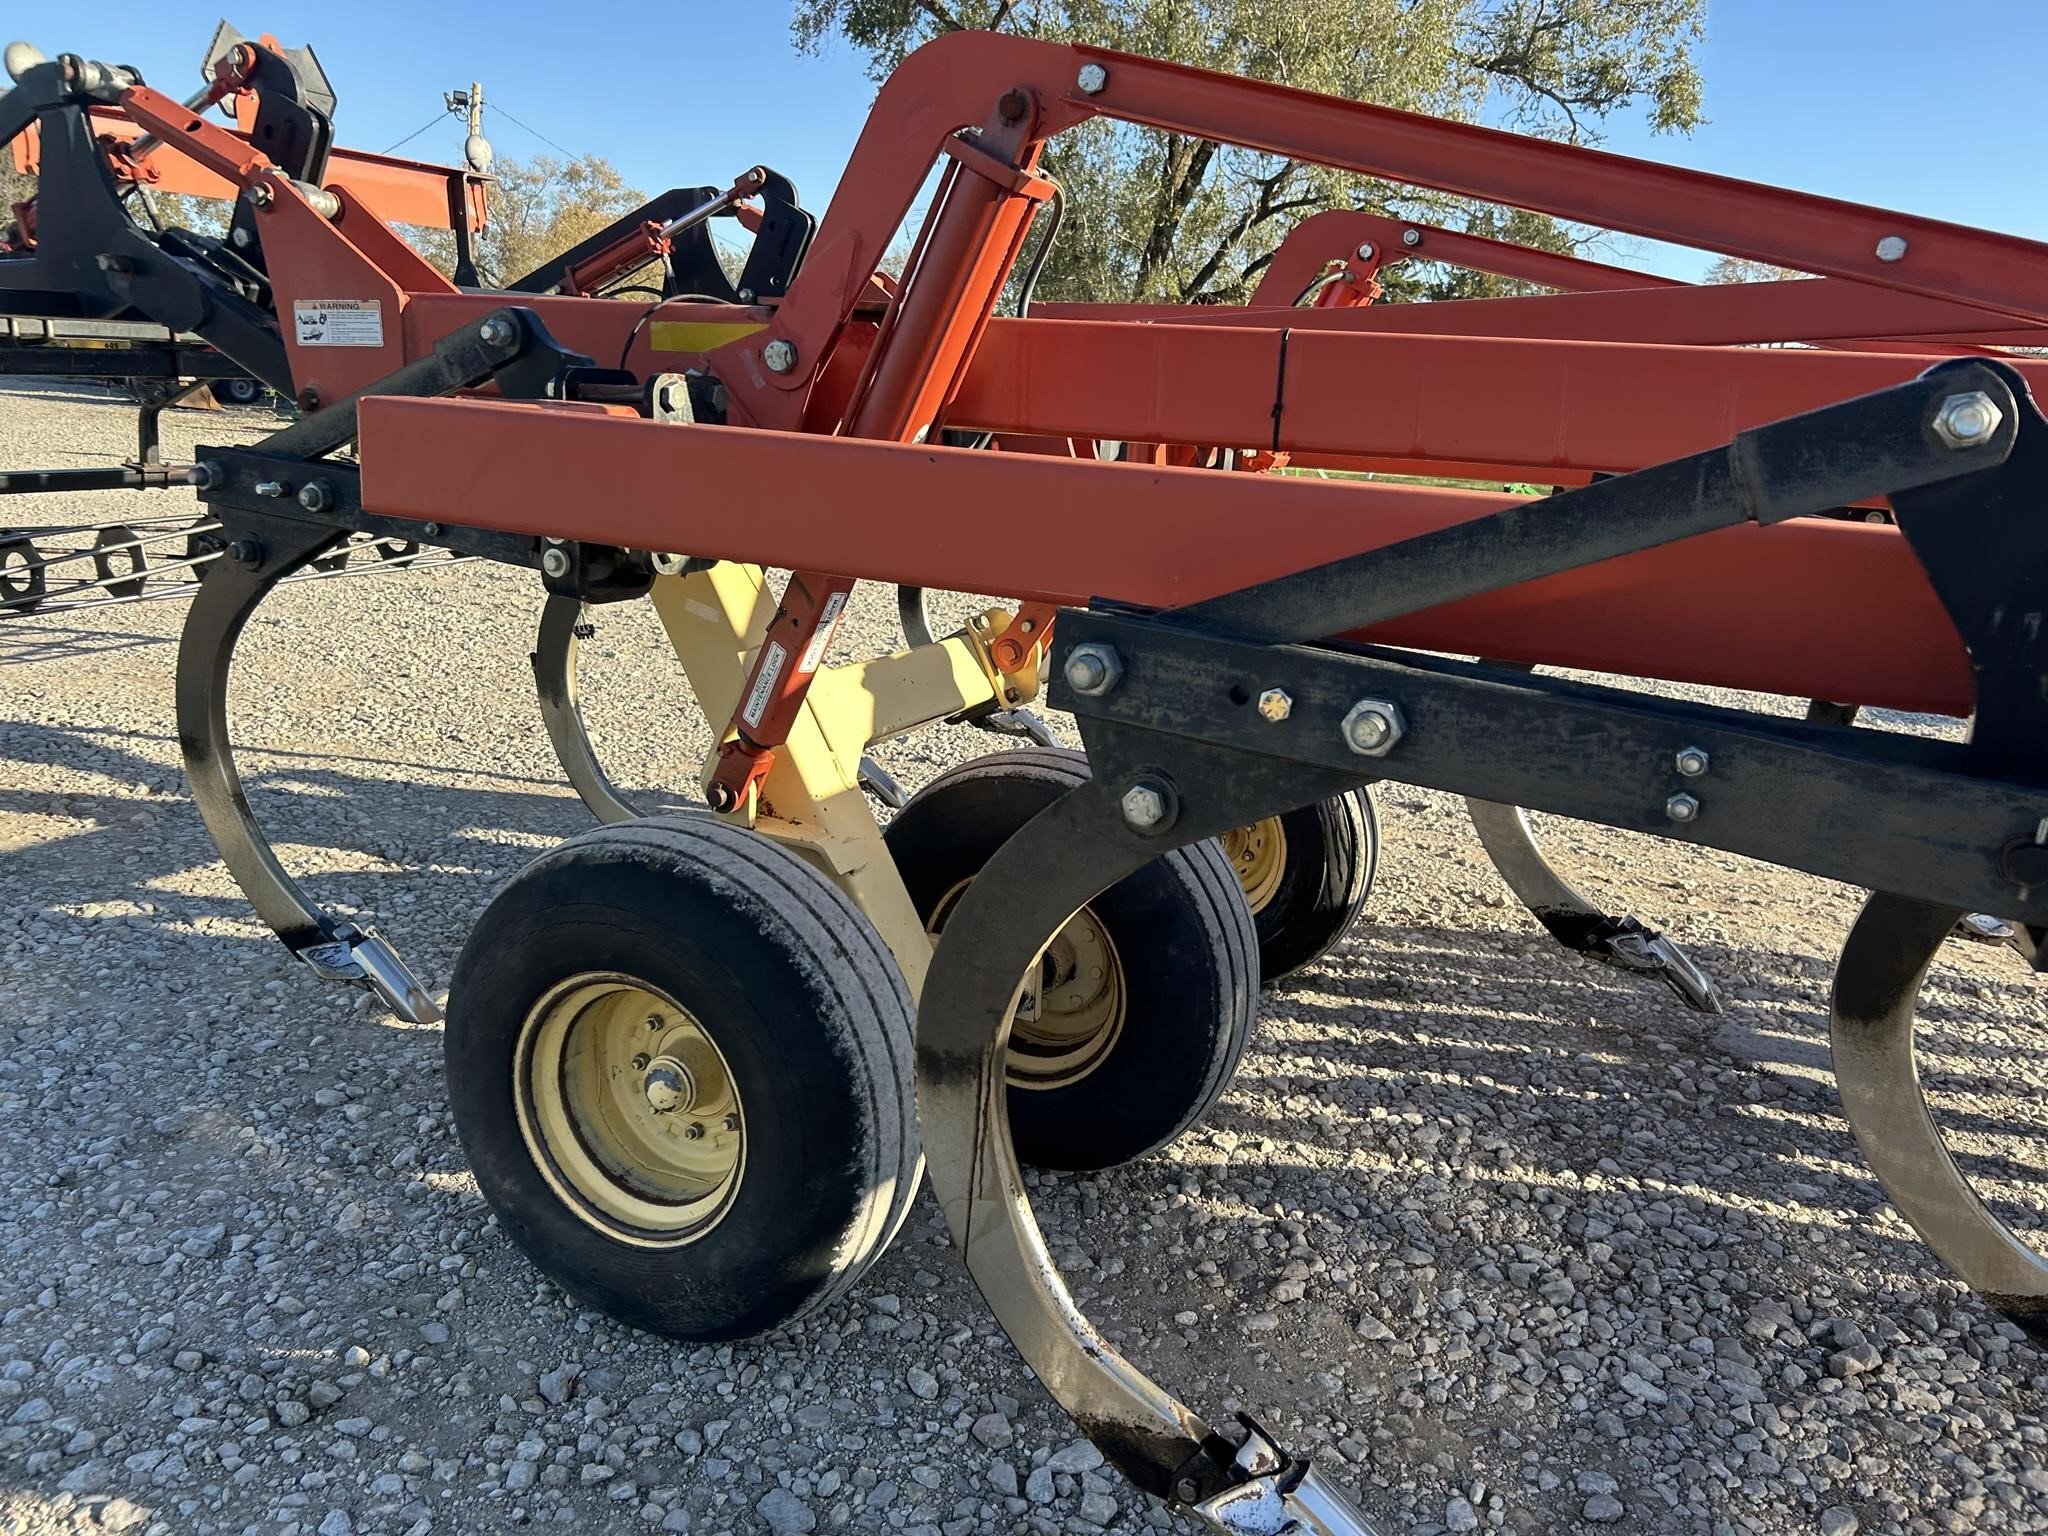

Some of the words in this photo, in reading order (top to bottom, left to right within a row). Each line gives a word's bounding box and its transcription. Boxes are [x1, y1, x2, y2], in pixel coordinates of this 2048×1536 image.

[319, 303, 360, 311] WARNING
[750, 672, 771, 719] MAINTENANCE
[769, 652, 780, 672] LOCK
